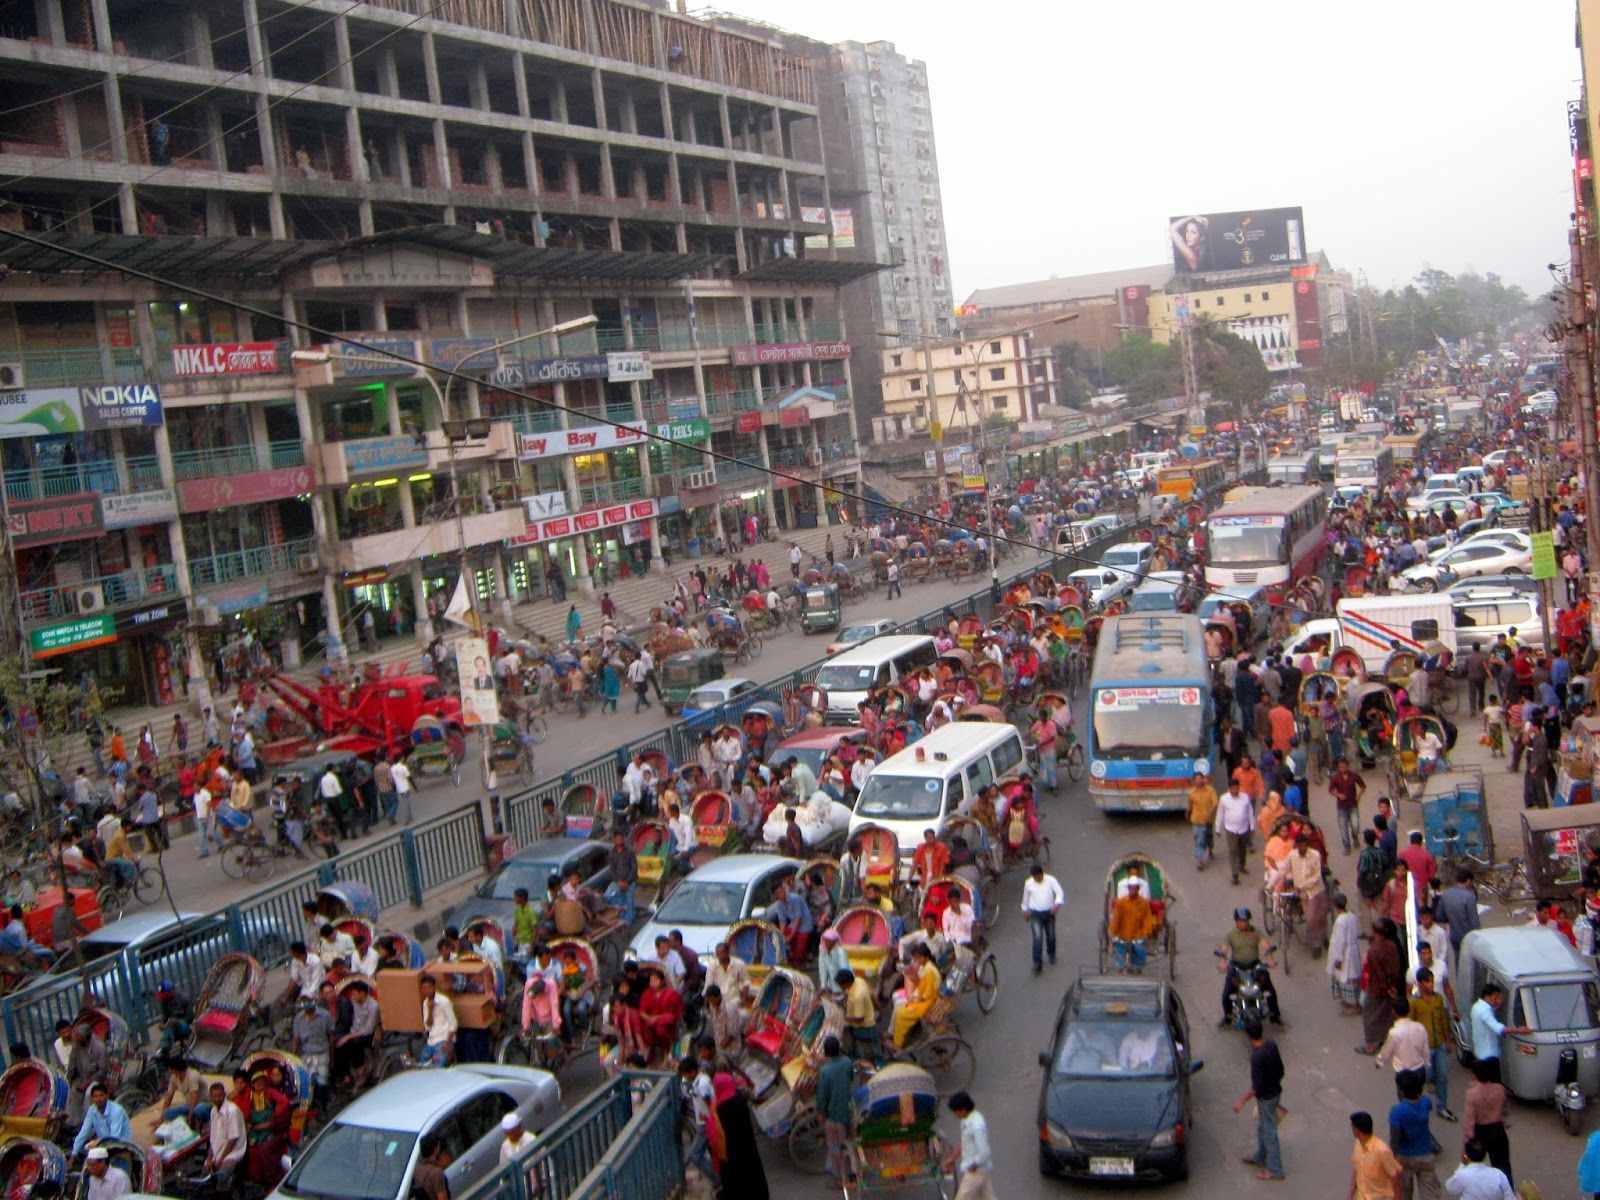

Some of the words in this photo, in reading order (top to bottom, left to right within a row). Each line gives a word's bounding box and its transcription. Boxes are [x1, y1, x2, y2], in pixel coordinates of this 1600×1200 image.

[173, 347, 226, 374] MKLC
[0, 394, 27, 406] UBEE
[82, 384, 157, 407] NOKIA
[121, 406, 147, 417] CENTRE
[567, 432, 597, 447] Bay
[614, 425, 643, 441] Bay
[28, 504, 94, 533] NEXT
